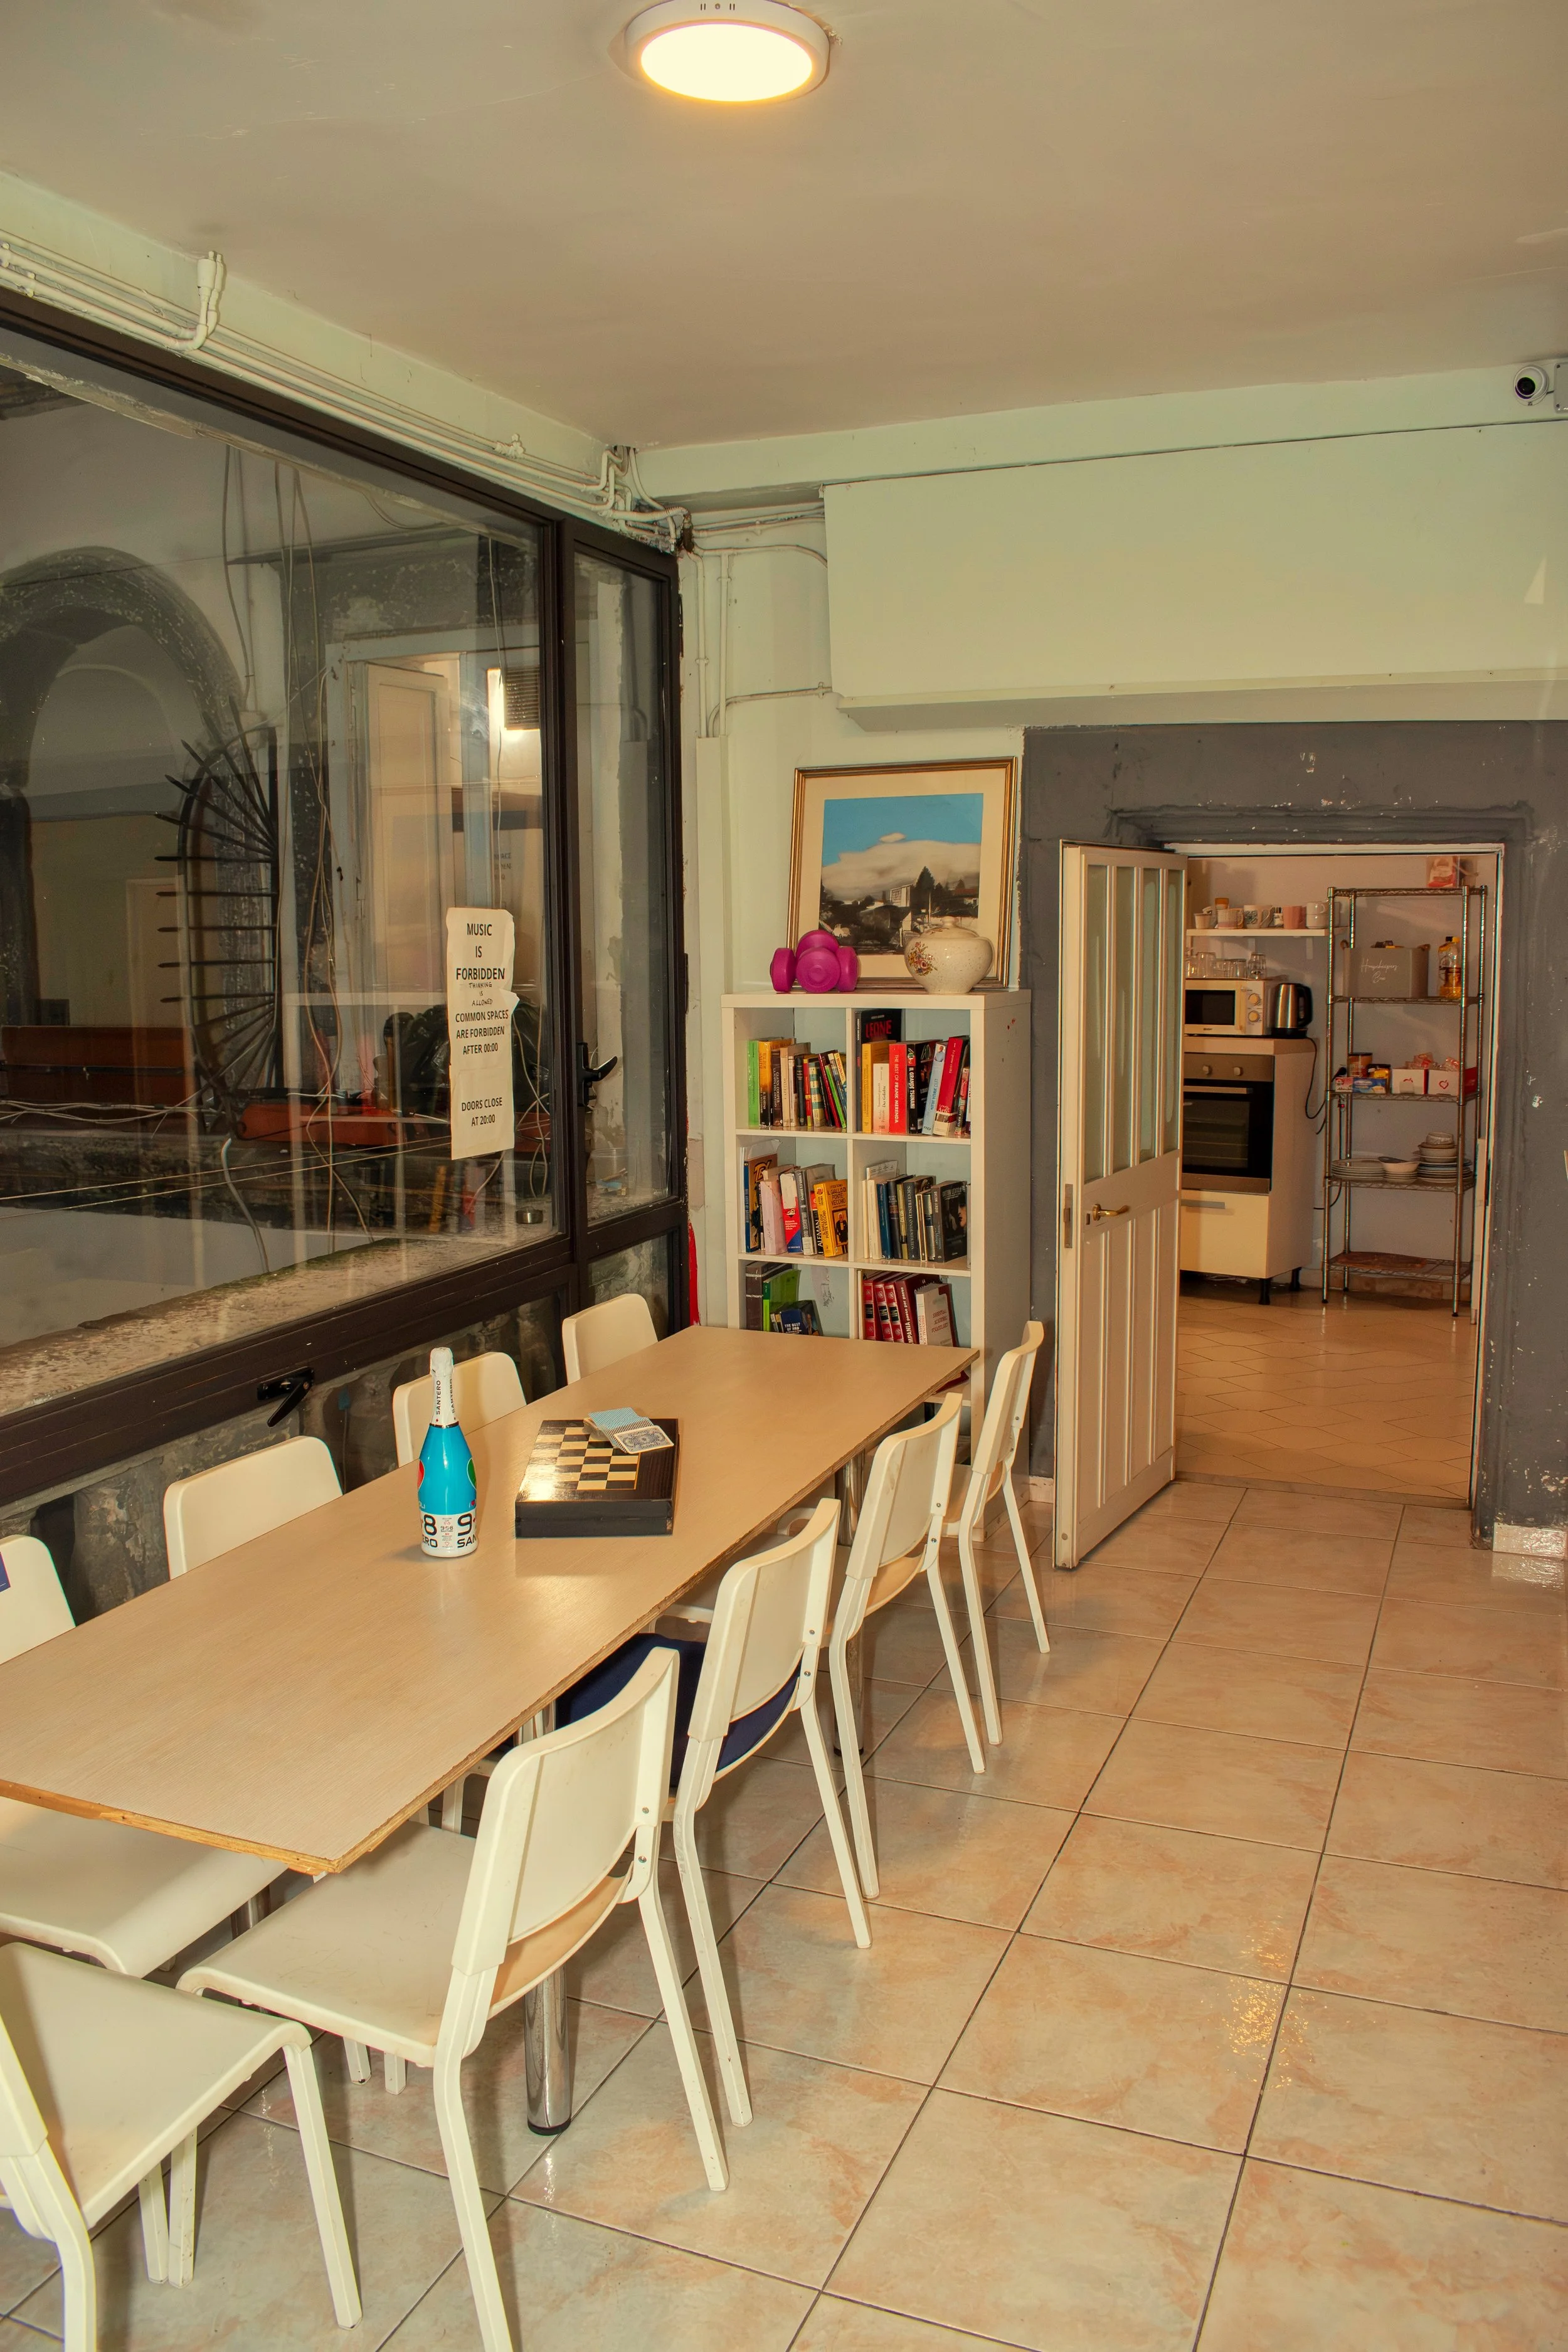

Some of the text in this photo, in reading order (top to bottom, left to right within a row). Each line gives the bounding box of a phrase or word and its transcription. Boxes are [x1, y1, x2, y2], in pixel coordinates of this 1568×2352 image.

[467, 923, 492, 936] MUSIC
[475, 945, 482, 958] IS
[456, 968, 505, 980] FORBIDDEN
[455, 1009, 509, 1022] COMMON SPACES
[456, 1026, 505, 1039] ARE FORBIDDEN
[865, 1020, 892, 1039] LEONE
[463, 1042, 499, 1055] AFTER 00:00
[461, 1097, 502, 1111] DOORS CLOSE
[471, 1114, 495, 1126] AT 20:00
[754, 1160, 772, 1182] TEX
[904, 1322, 914, 1343] MPANIA
[423, 1514, 437, 1536] 8
[457, 1513, 472, 1537] 9
